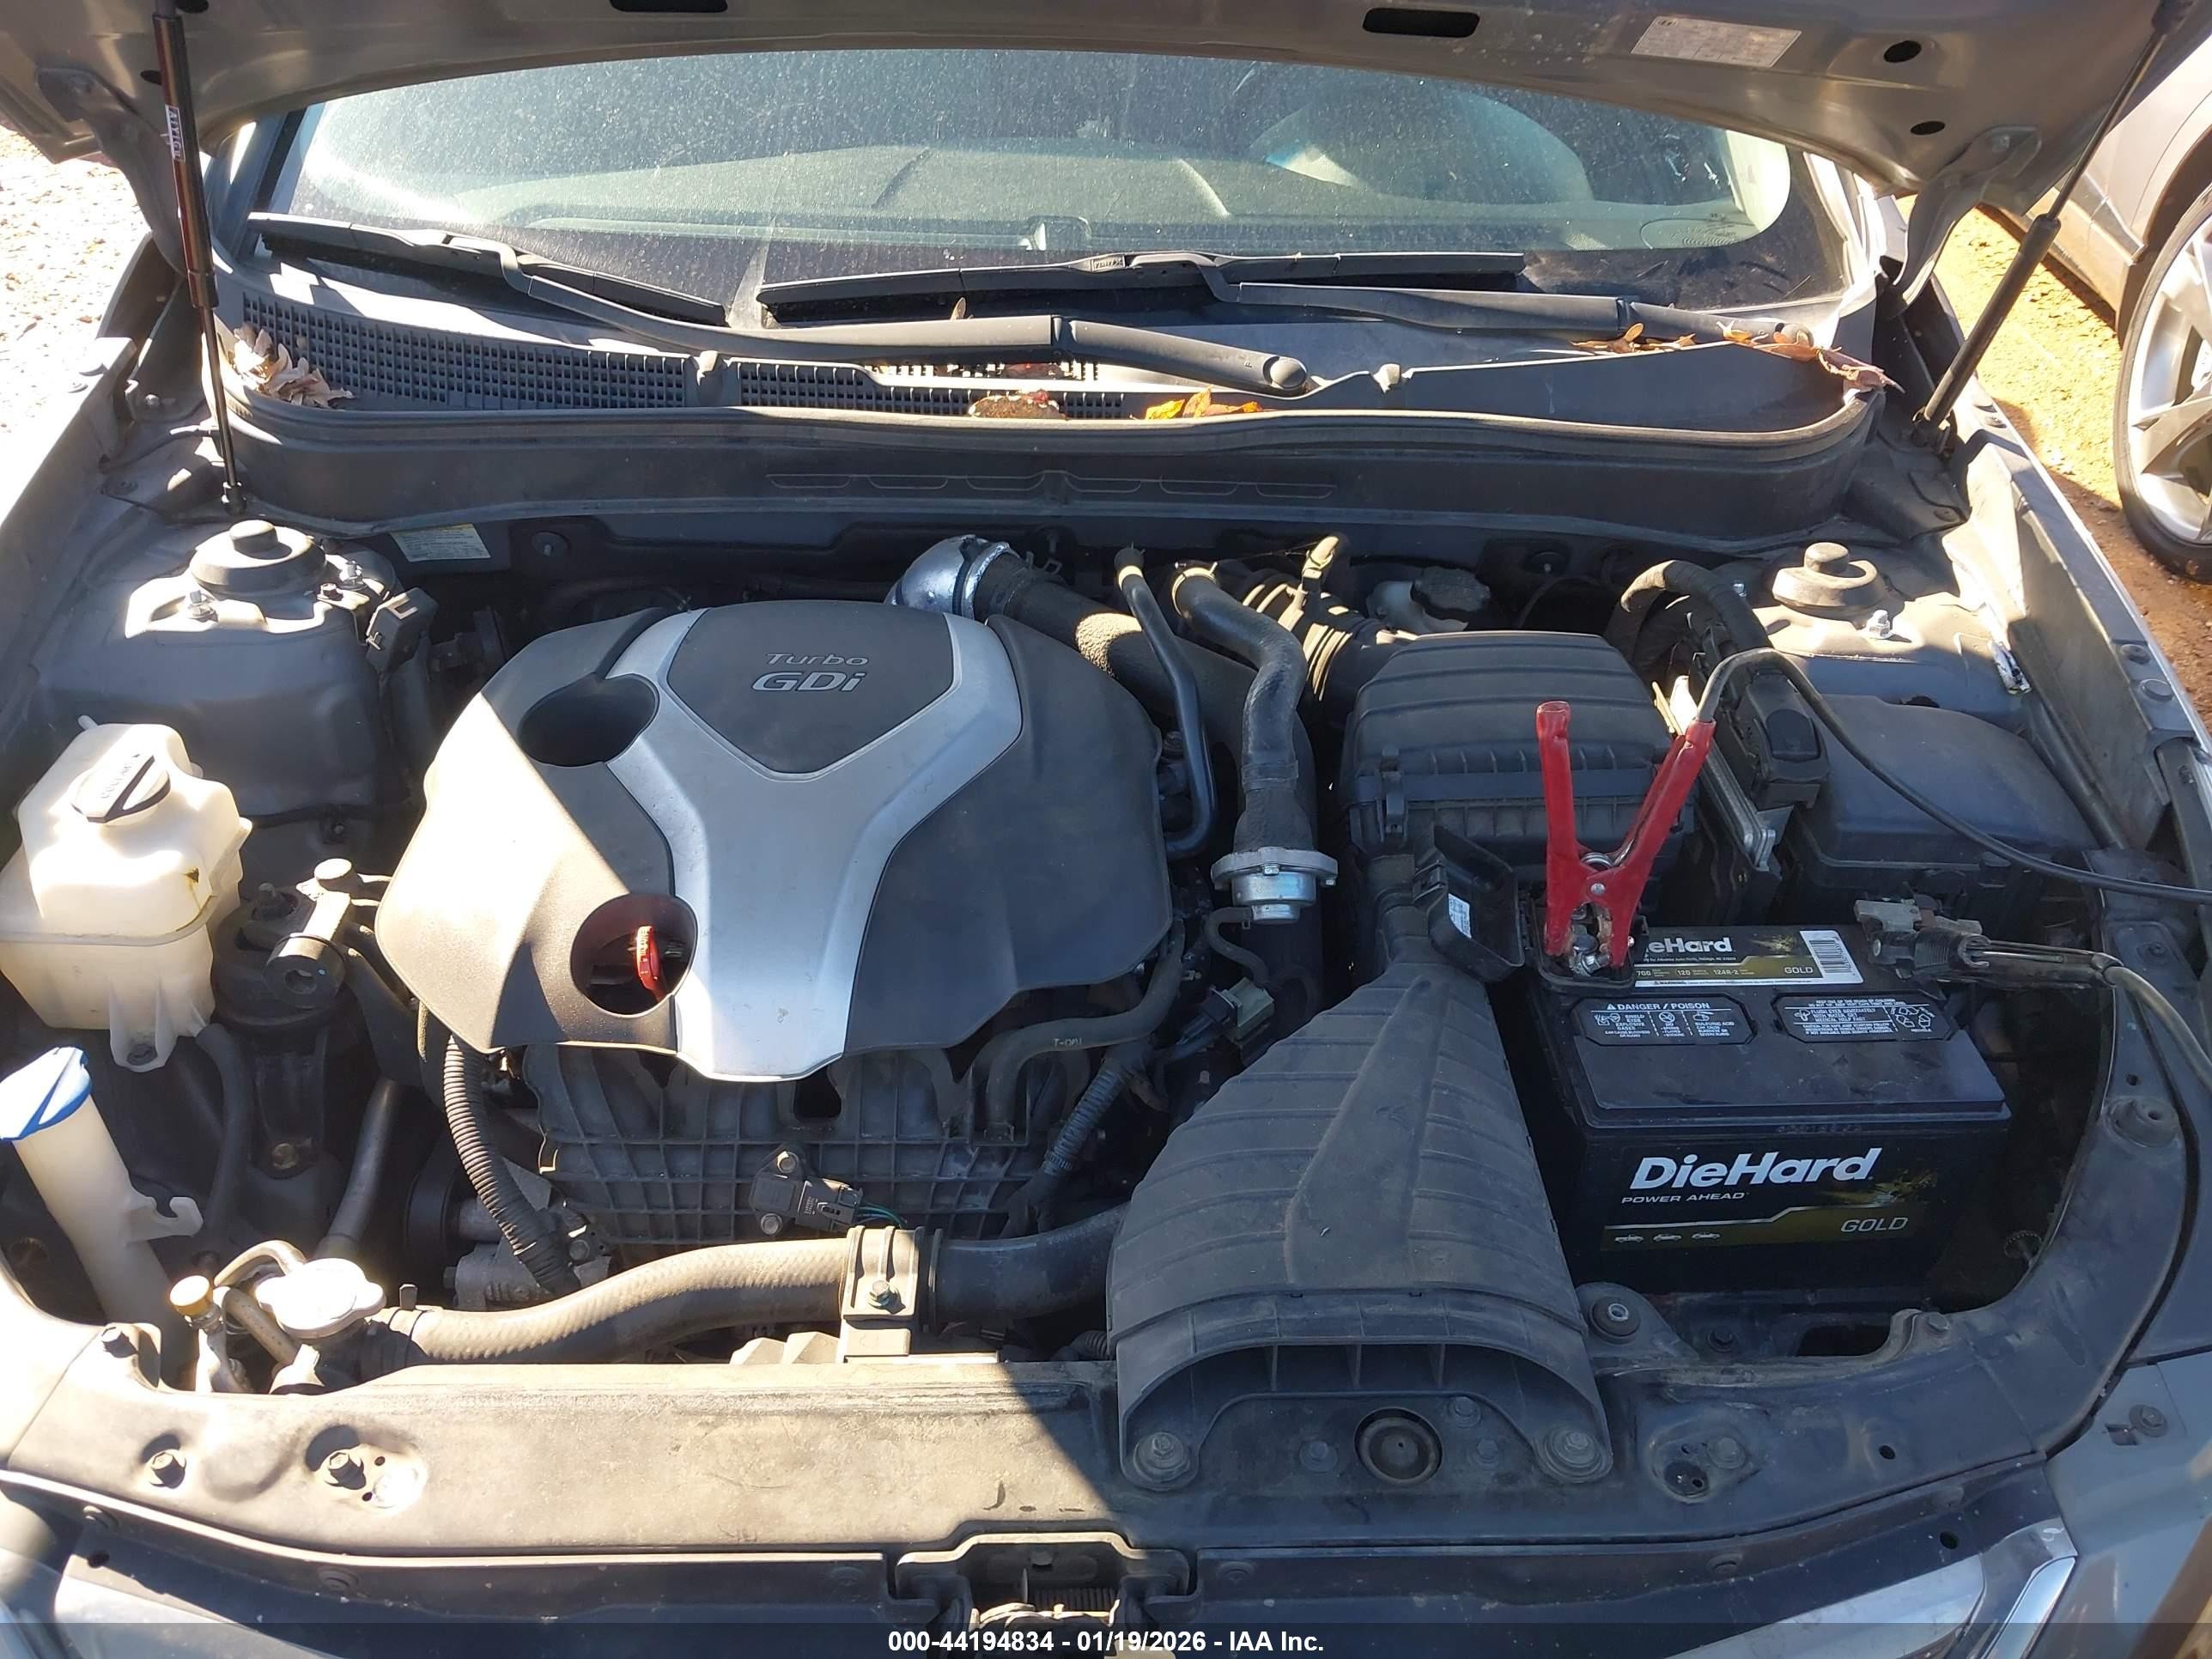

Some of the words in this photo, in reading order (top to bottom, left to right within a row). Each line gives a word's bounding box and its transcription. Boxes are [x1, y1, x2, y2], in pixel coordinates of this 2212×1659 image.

[766, 653, 869, 665] Turbo
[751, 672, 867, 691] GDi
[1630, 1147, 1882, 1190] DieHard
[1621, 1194, 1681, 1204] POWER
[1686, 1193, 1745, 1202] AHEAD
[1840, 1217, 1909, 1233] GOLD
